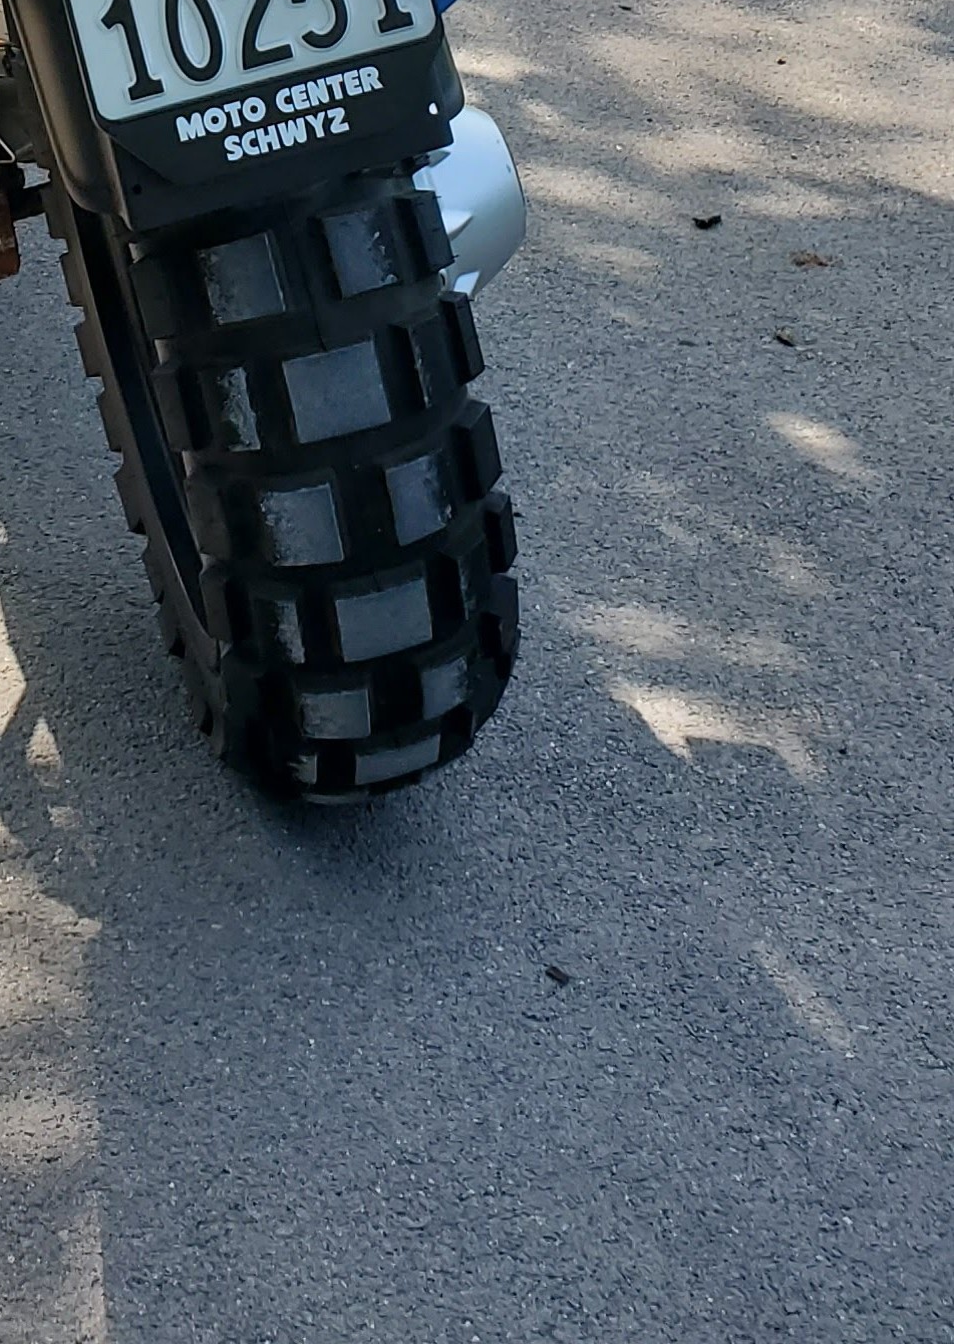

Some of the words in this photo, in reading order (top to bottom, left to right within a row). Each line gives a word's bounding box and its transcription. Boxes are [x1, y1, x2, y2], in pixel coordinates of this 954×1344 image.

[175, 96, 267, 143] MOTO
[275, 65, 385, 114] CENTER
[223, 107, 350, 162] SCHWYZ
